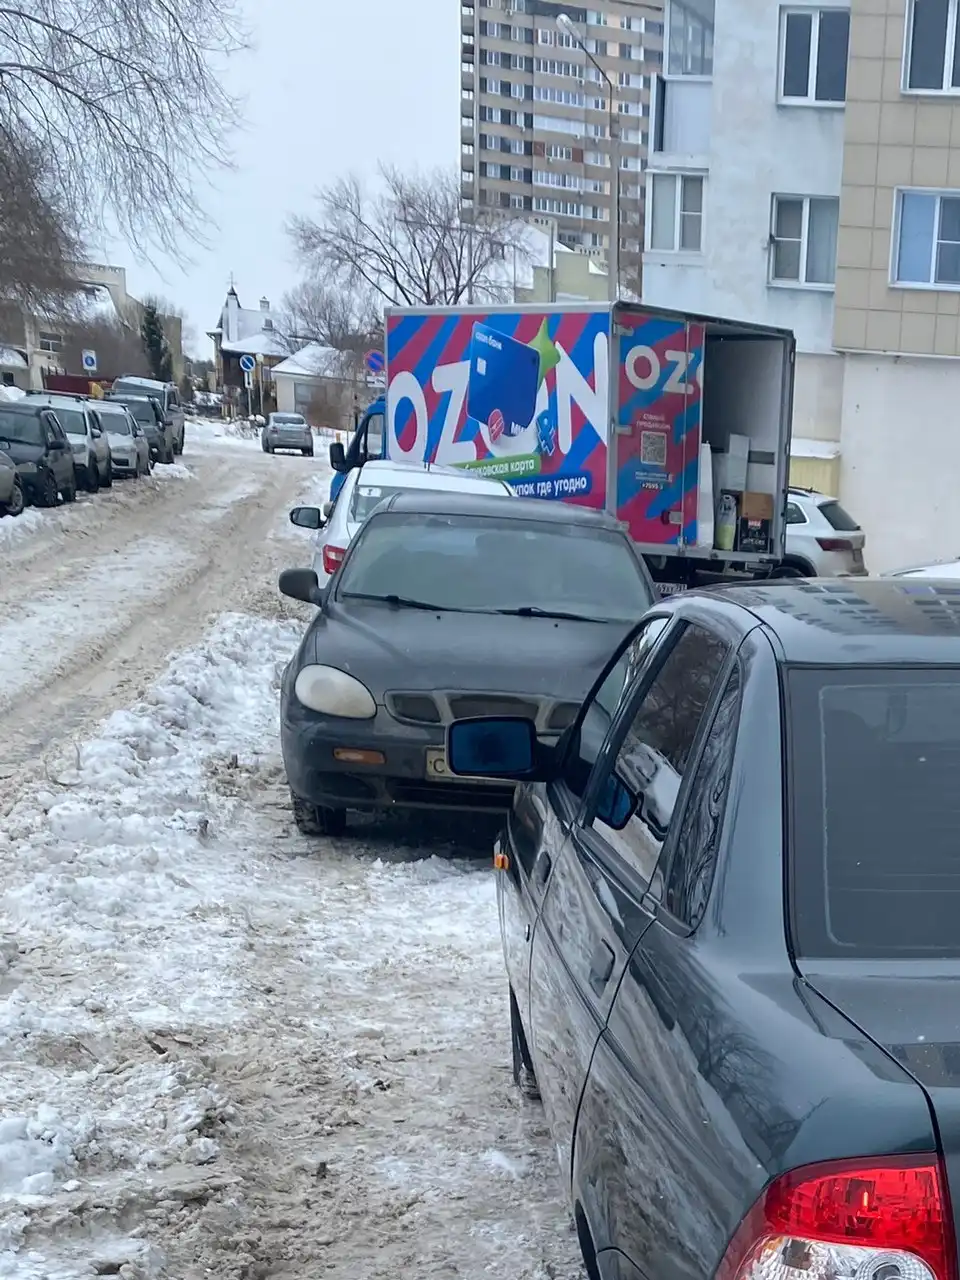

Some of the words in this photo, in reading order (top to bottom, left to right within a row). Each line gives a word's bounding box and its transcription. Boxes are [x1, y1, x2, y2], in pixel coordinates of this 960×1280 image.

[465, 463, 509, 477] бковская
[510, 459, 535, 475] карта
[537, 481, 552, 497] где
[553, 477, 587, 497] угодно
